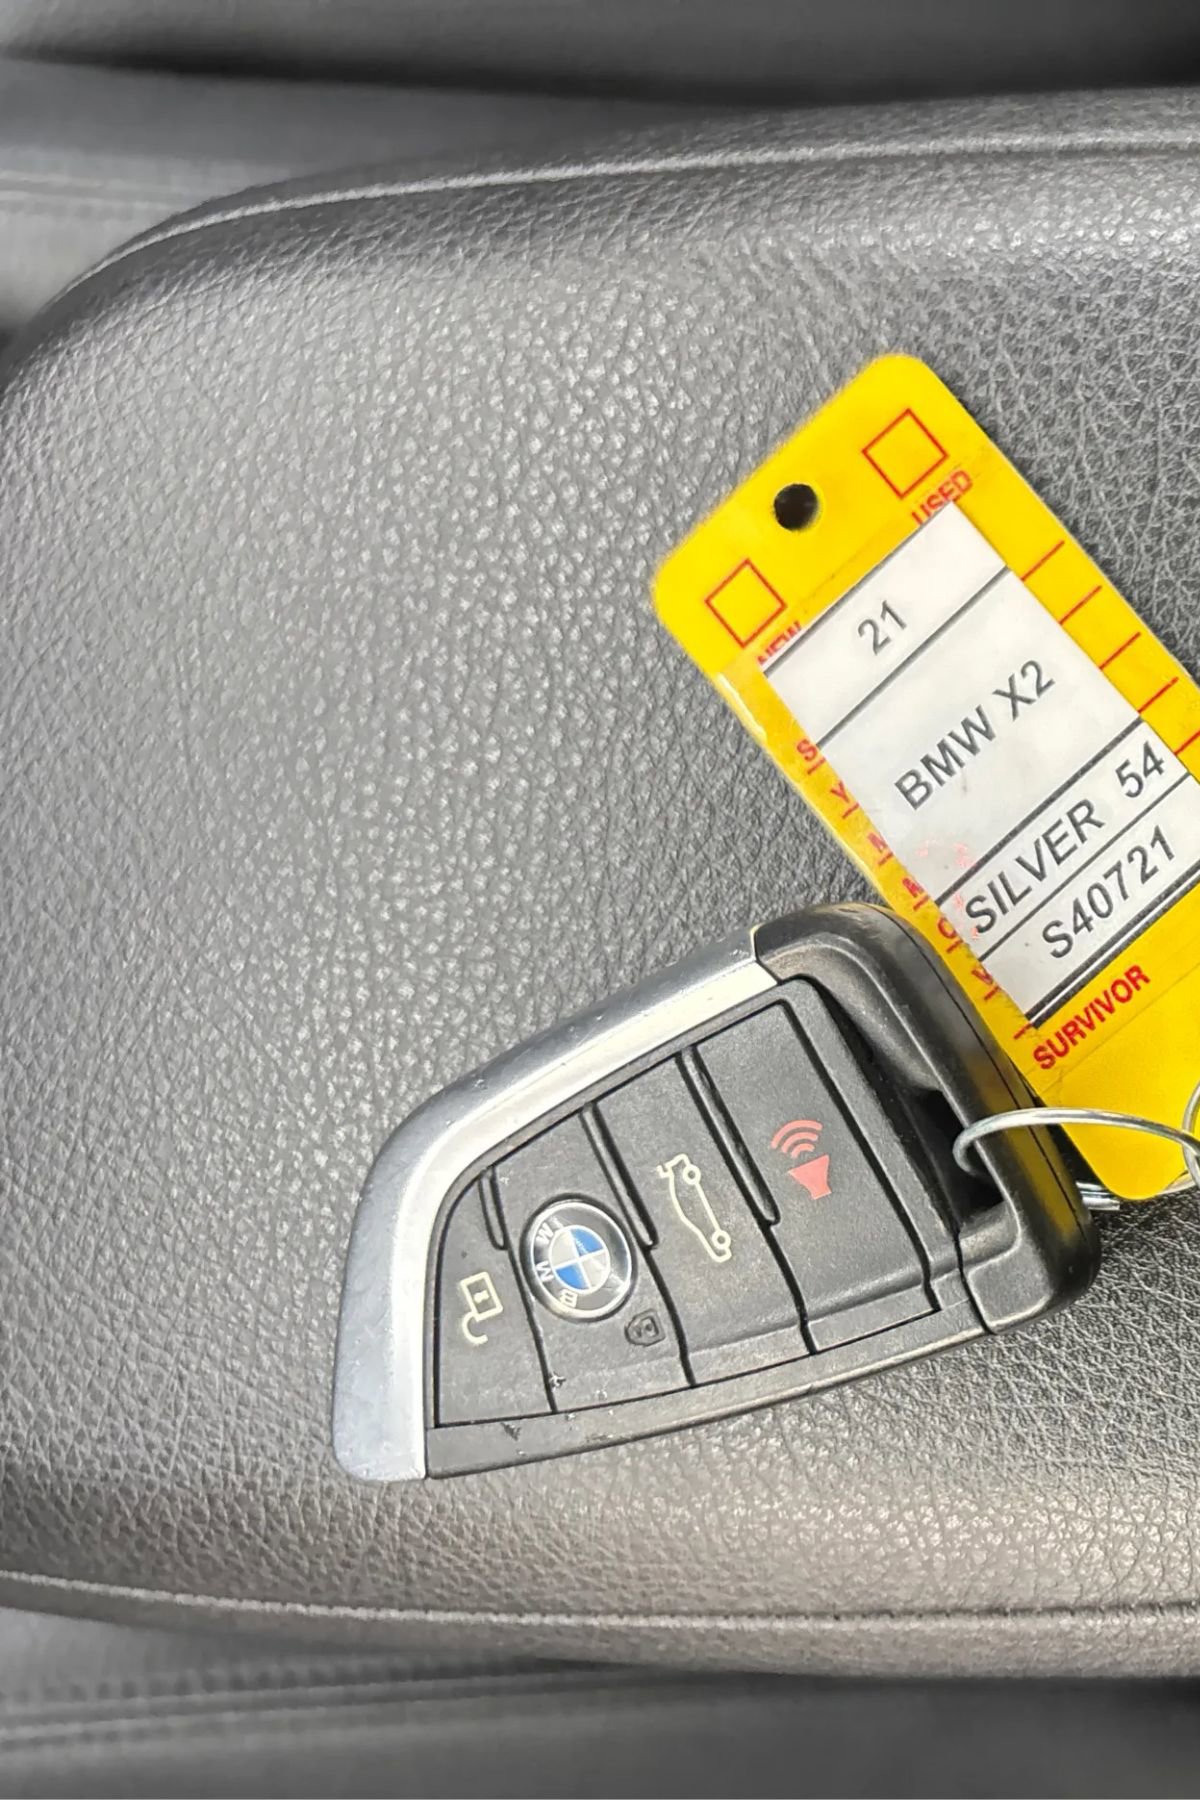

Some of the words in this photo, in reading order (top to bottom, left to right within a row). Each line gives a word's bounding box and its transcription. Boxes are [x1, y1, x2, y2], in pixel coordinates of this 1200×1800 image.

[858, 600, 907, 655] 21
[894, 705, 996, 810] BMW
[992, 659, 1055, 721] X2
[965, 799, 1105, 934] SILVER
[1115, 741, 1166, 799] 54
[1042, 825, 1176, 959] S40721
[1033, 965, 1151, 1070] SURVIVOR
